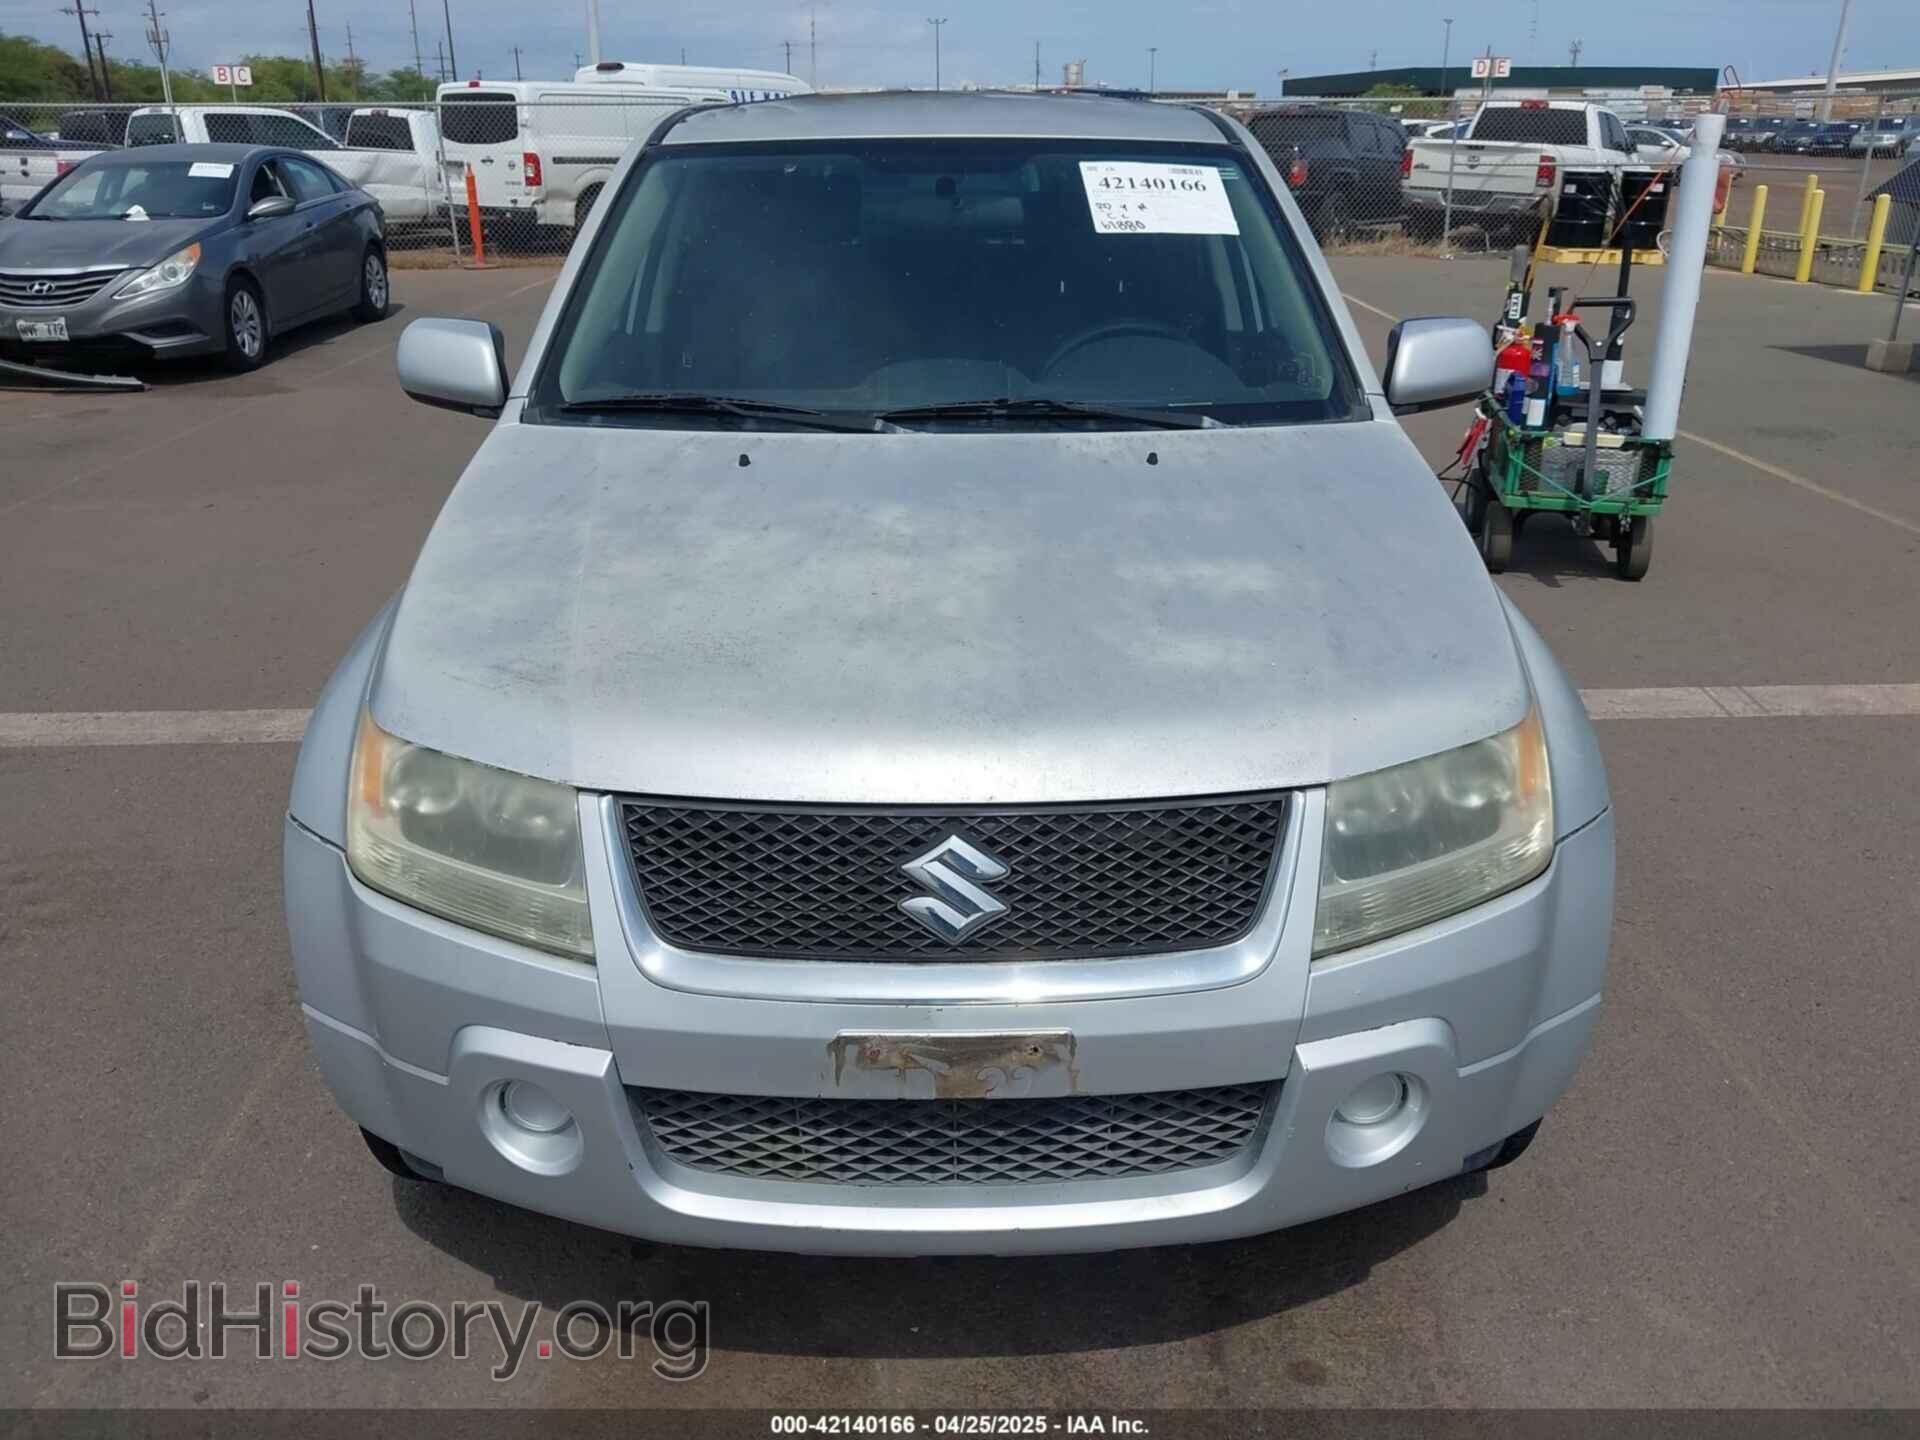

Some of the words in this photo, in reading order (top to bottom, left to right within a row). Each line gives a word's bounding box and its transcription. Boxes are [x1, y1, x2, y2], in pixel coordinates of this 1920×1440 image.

[217, 67, 228, 82] B
[238, 68, 248, 82] C
[1098, 176, 1207, 192] 42140166
